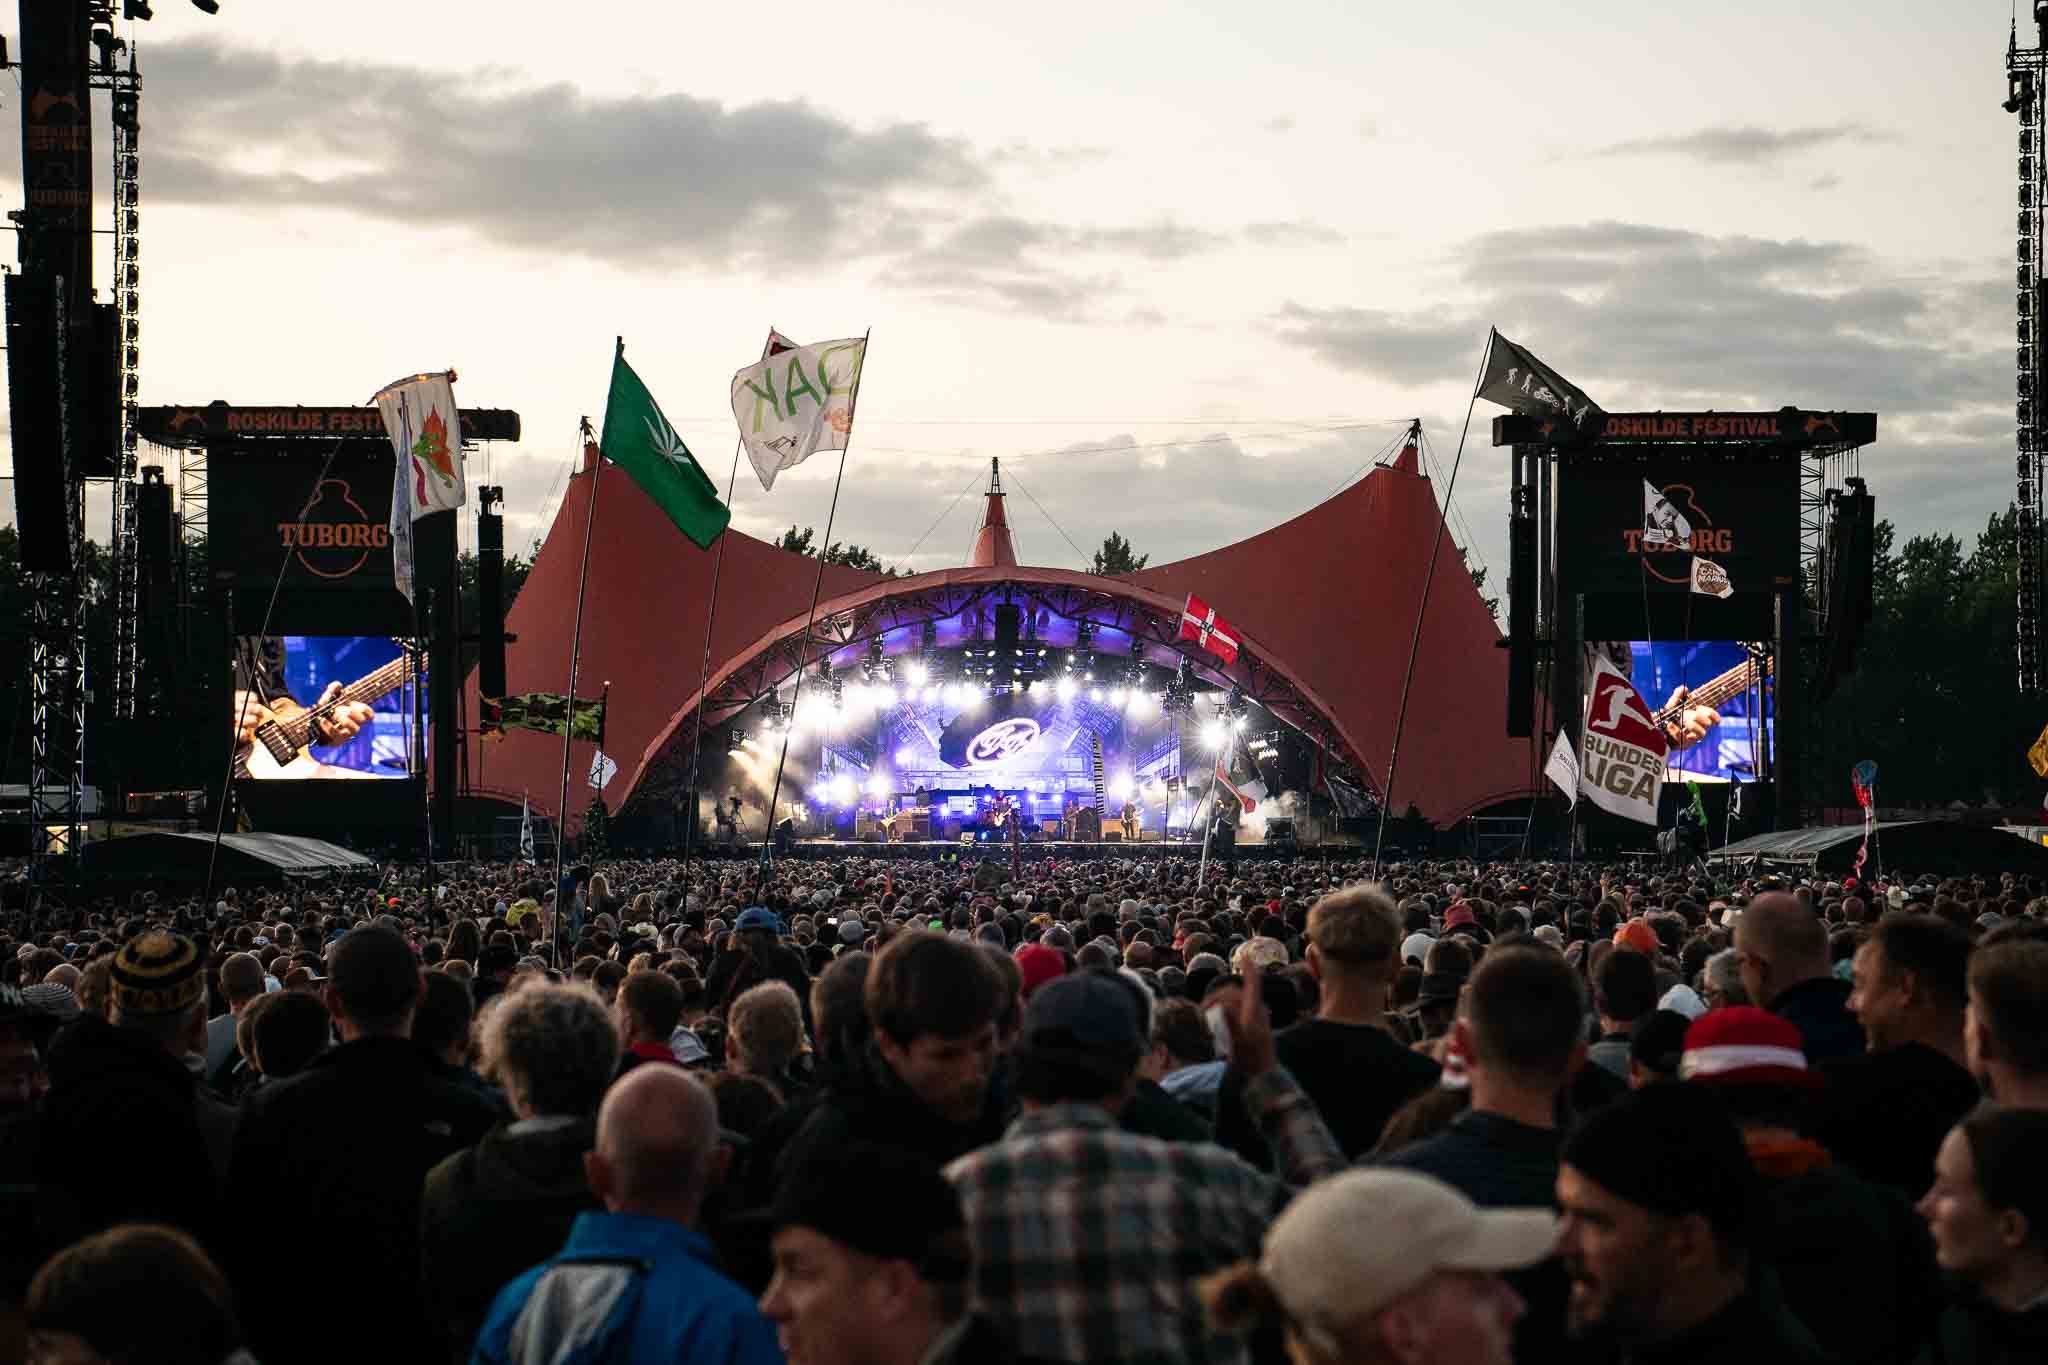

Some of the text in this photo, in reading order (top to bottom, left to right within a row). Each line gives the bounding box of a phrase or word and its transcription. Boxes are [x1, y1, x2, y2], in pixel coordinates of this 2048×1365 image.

[227, 411, 383, 432] ROSKILDE FESTI
[1606, 416, 1690, 436] OSKILDE
[277, 522, 389, 548] TUBORG
[1624, 528, 1734, 552] TORG
[1585, 734, 1662, 775] BUNDES
[1585, 751, 1656, 806] LIGA
